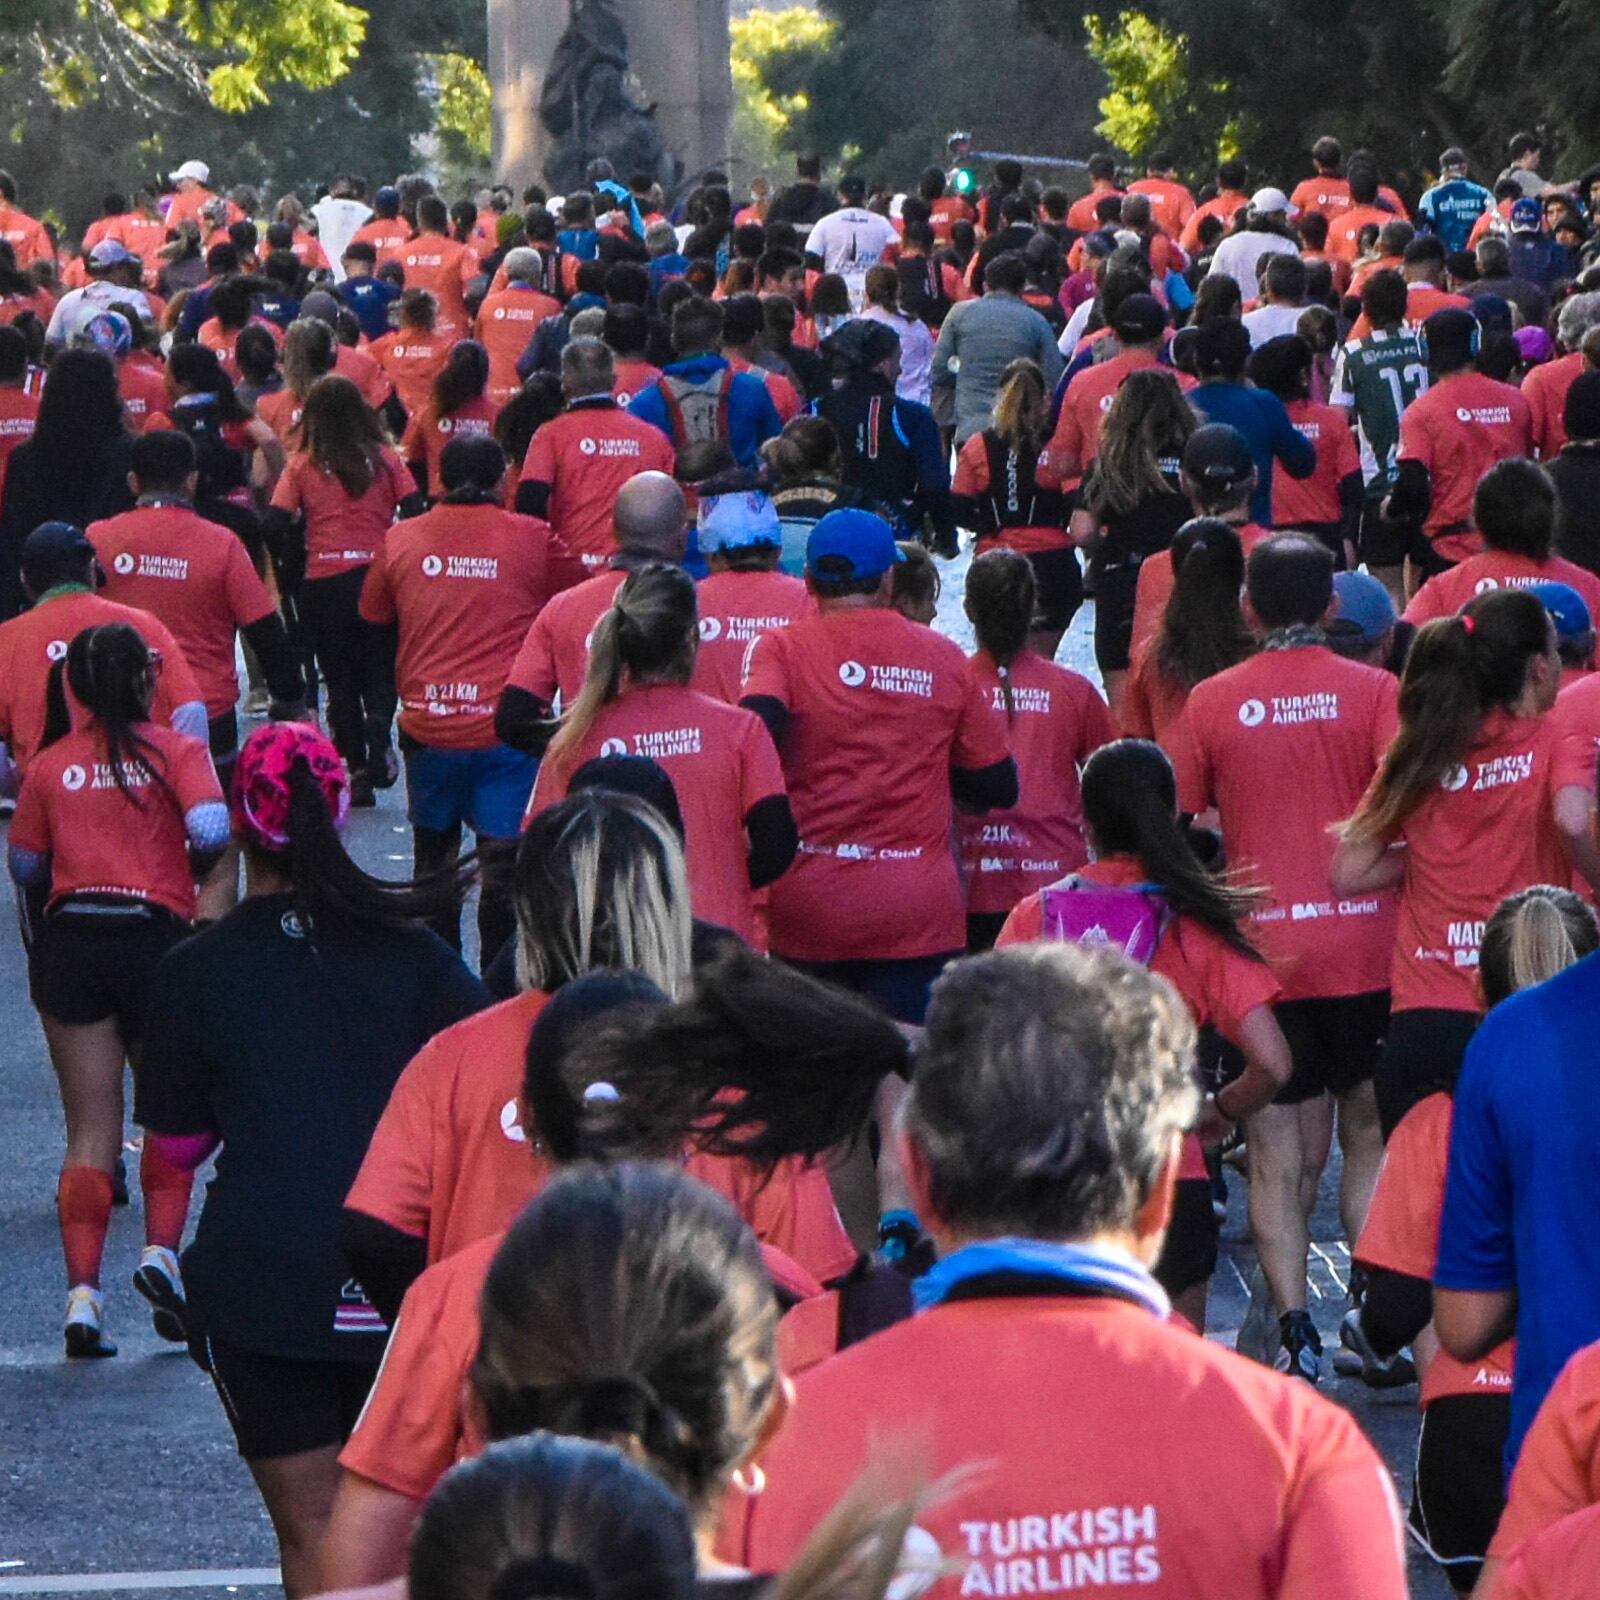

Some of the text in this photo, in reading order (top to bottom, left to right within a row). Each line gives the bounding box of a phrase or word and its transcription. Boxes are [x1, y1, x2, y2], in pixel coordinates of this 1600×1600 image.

[139, 554, 188, 570] TURKISH
[447, 555, 498, 569] TURKISH
[137, 564, 188, 580] AIRLINES
[445, 565, 498, 579] AIRLINES
[727, 616, 789, 629] TURKISH
[870, 664, 934, 684] TURKISH
[456, 682, 479, 701] KM
[870, 678, 934, 699] AIRLINES
[991, 698, 1051, 713] AILINES
[1271, 692, 1337, 709] TURKISH
[1272, 704, 1338, 724] AIRLINES
[633, 727, 701, 747] TURKISH
[633, 740, 701, 758] AIRLINES
[959, 1503, 1158, 1557] TURKISH
[959, 1545, 1161, 1598] AIRLINES
